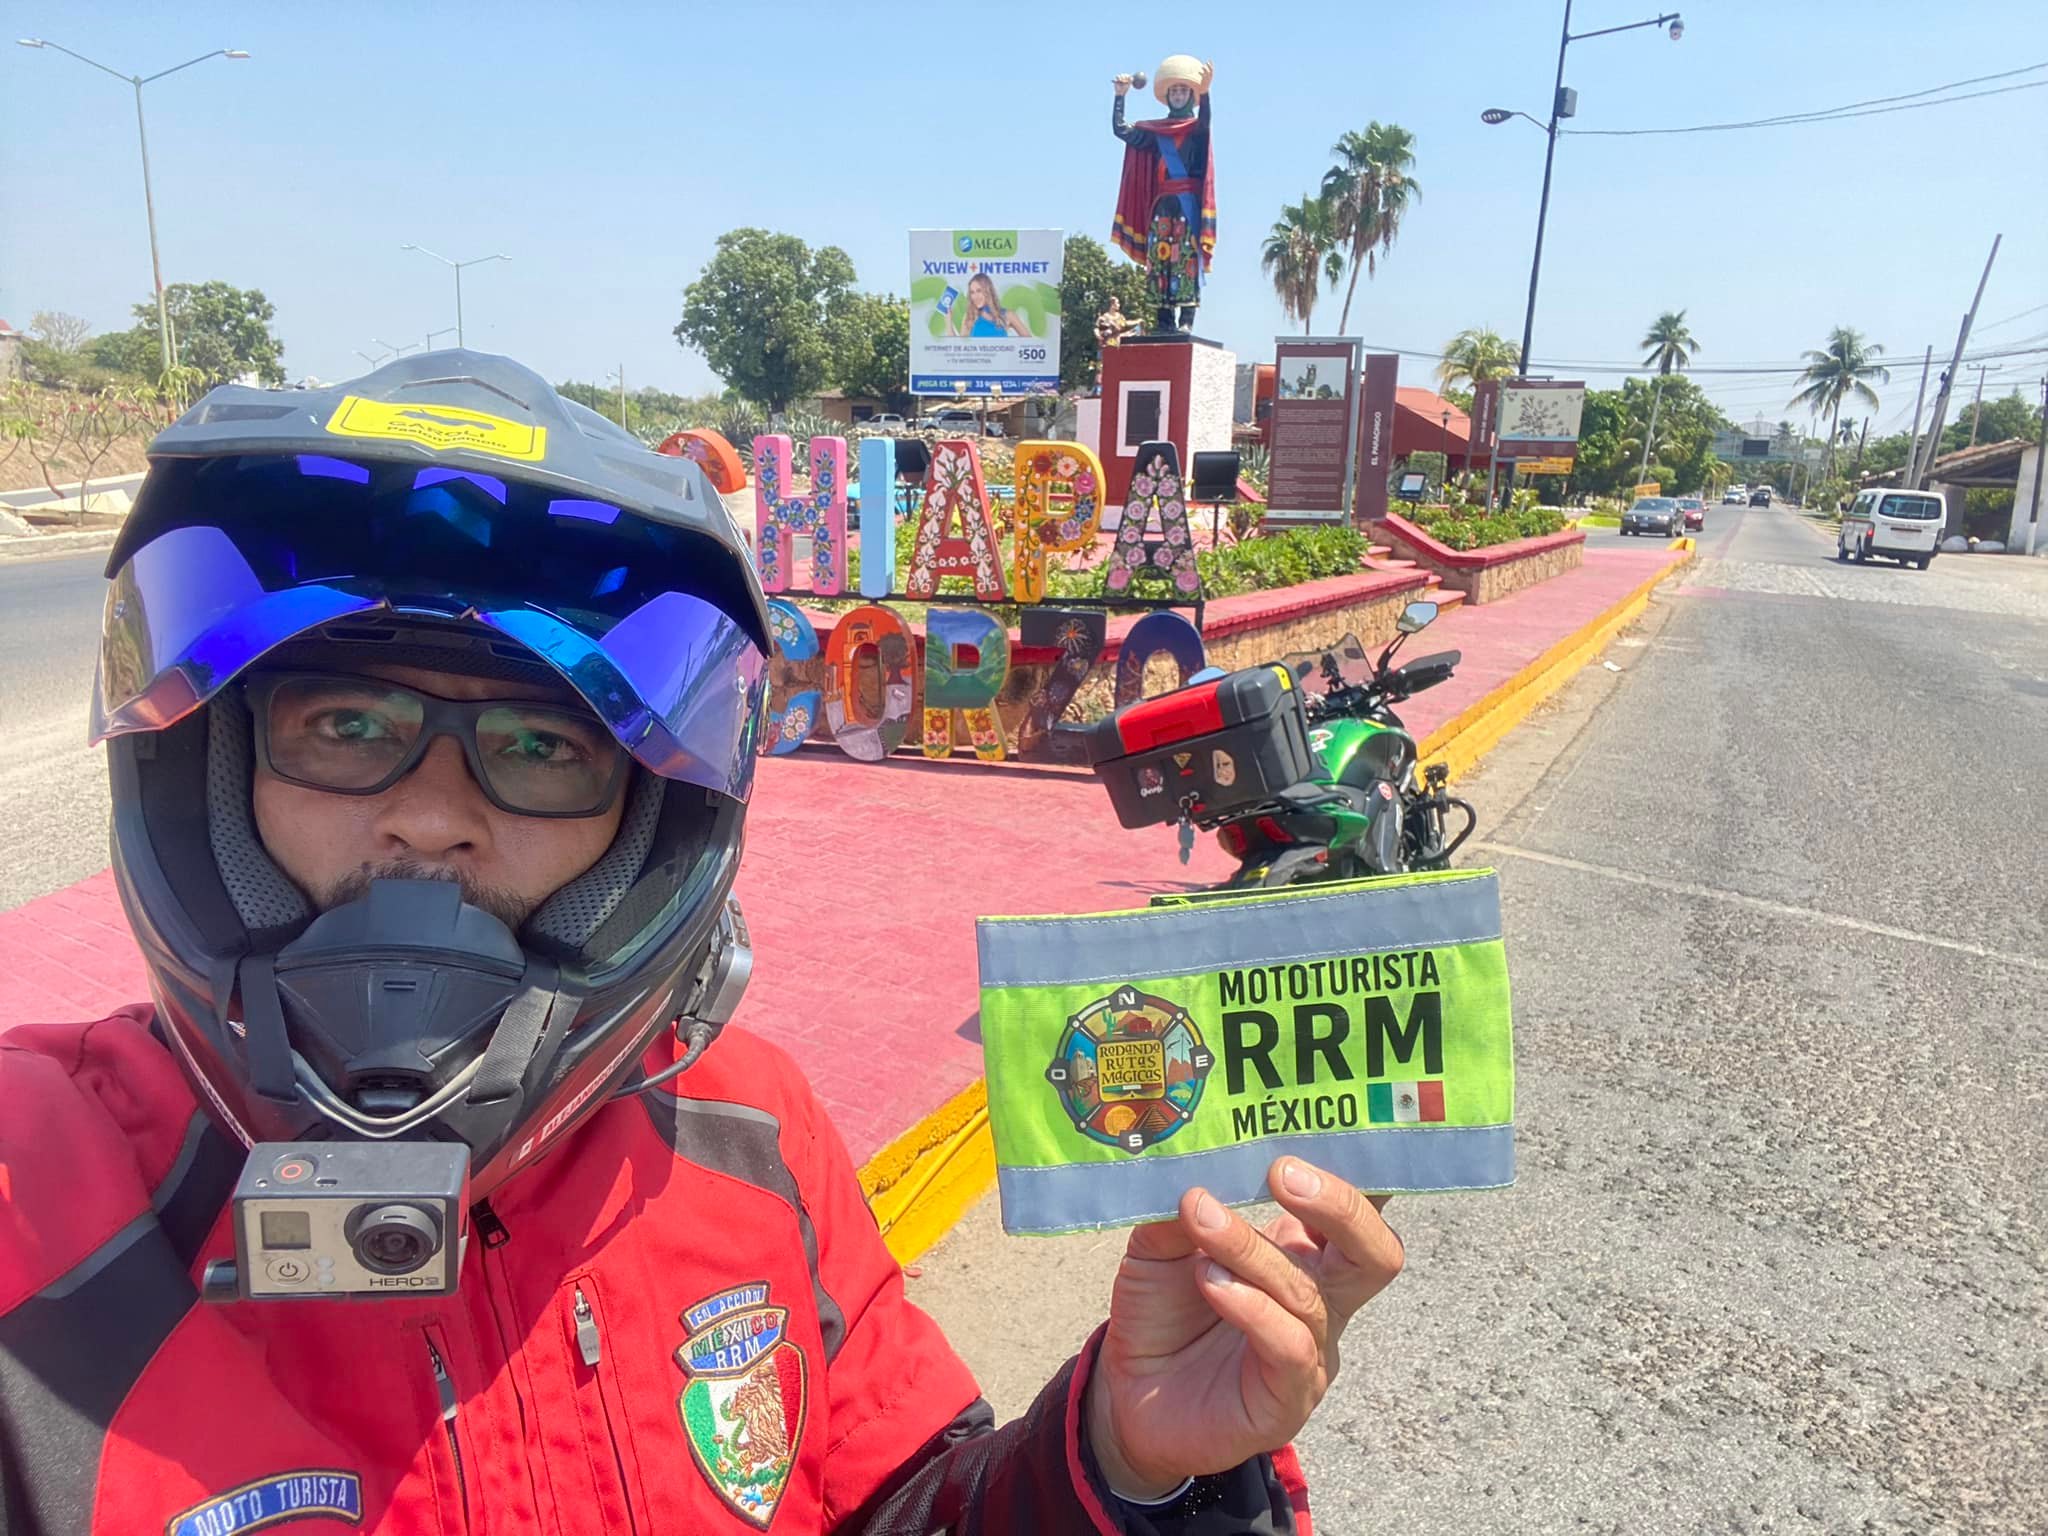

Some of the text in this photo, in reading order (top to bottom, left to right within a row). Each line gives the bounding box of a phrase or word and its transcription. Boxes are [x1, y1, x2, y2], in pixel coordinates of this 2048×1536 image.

[974, 238, 1012, 250] MEGA
[923, 261, 969, 275] XVIEW
[979, 261, 1049, 275] INTERNET
[1018, 348, 1046, 360] $500
[1371, 411, 1382, 466] EL PARACHICO
[1219, 951, 1440, 1008] MOTOTURISTA
[1117, 992, 1135, 1006] N
[1222, 991, 1444, 1095] RRM
[1196, 1055, 1209, 1067] E
[1051, 1068, 1067, 1081] O
[1232, 1093, 1357, 1142] MÉXICO
[1128, 1134, 1143, 1147] S
[695, 1307, 711, 1323] EN
[716, 1336, 761, 1370] RRM
[194, 1476, 348, 1536] MOTO TURISTA
